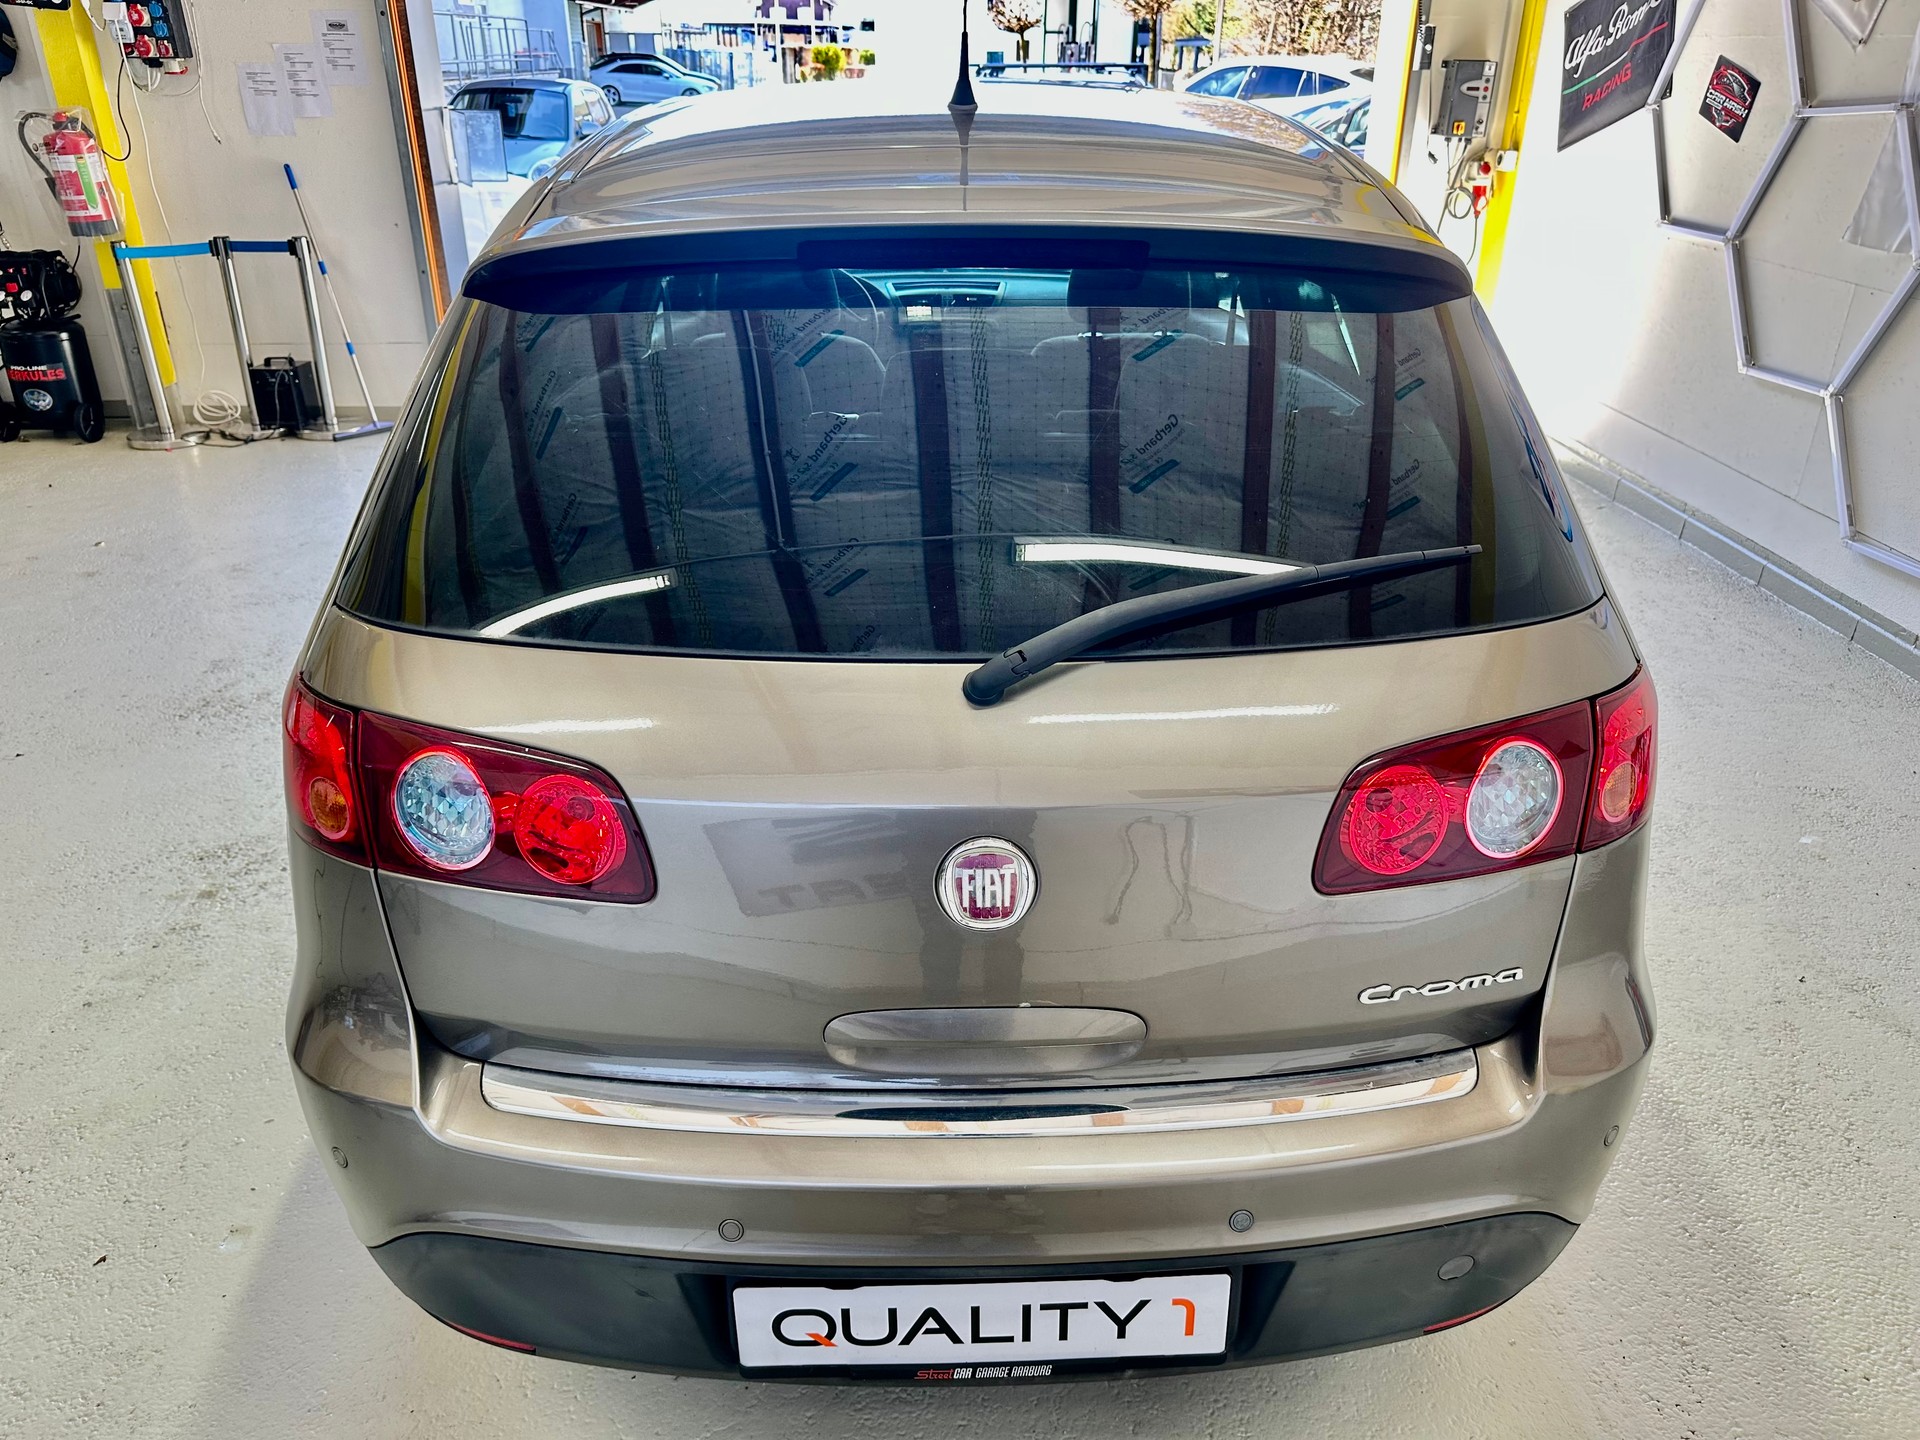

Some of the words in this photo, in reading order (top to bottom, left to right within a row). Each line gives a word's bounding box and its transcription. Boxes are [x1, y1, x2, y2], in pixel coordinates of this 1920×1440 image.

[1564, 24, 1607, 78] Alfa
[1582, 62, 1632, 111] RACING
[1706, 88, 1727, 105] CAR
[1723, 98, 1749, 118] WASH
[956, 866, 1016, 908] FIAT
[1358, 966, 1523, 1005] Croma
[771, 1298, 1152, 1347] QUALITY
[1172, 1297, 1195, 1337] 1
[976, 1366, 1010, 1379] GARAGE
[1011, 1364, 1053, 1377] AARBURG
